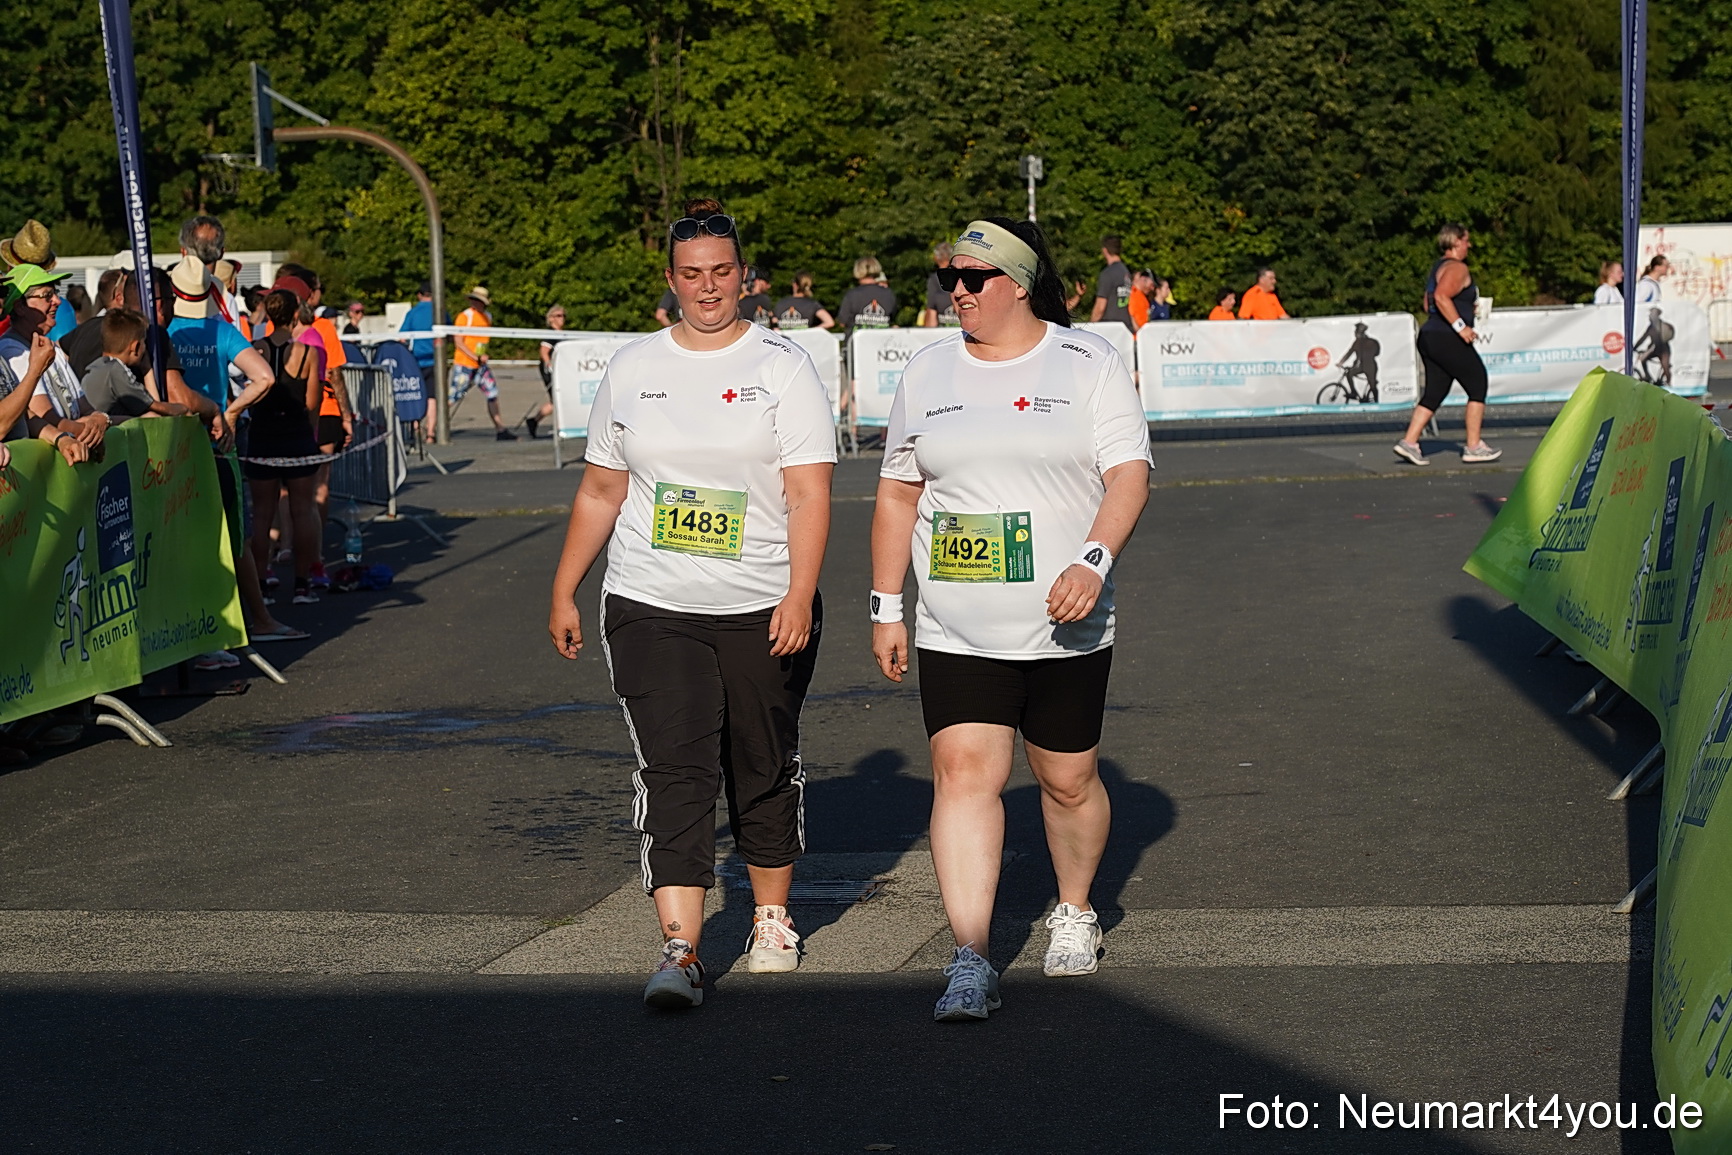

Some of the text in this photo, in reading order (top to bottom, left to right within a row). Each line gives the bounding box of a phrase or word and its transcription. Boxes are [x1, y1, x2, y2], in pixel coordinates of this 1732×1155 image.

[762, 338, 786, 350] CRAFT
[1061, 342, 1087, 356] CRAFT
[1161, 343, 1194, 355] NOW
[1163, 363, 1215, 377] E-BIKES
[640, 391, 667, 400] Sarah
[1034, 397, 1070, 406] Bayerisches
[925, 403, 964, 418] Madeleine
[101, 495, 129, 521] Fischer
[656, 508, 666, 540] WALK
[668, 507, 728, 535] 1483
[667, 530, 725, 545] Sossau Sarah
[728, 518, 740, 549] 2022
[941, 536, 989, 560] 1492
[937, 560, 993, 569] Schauer Madeleine
[991, 541, 1001, 573] 2022
